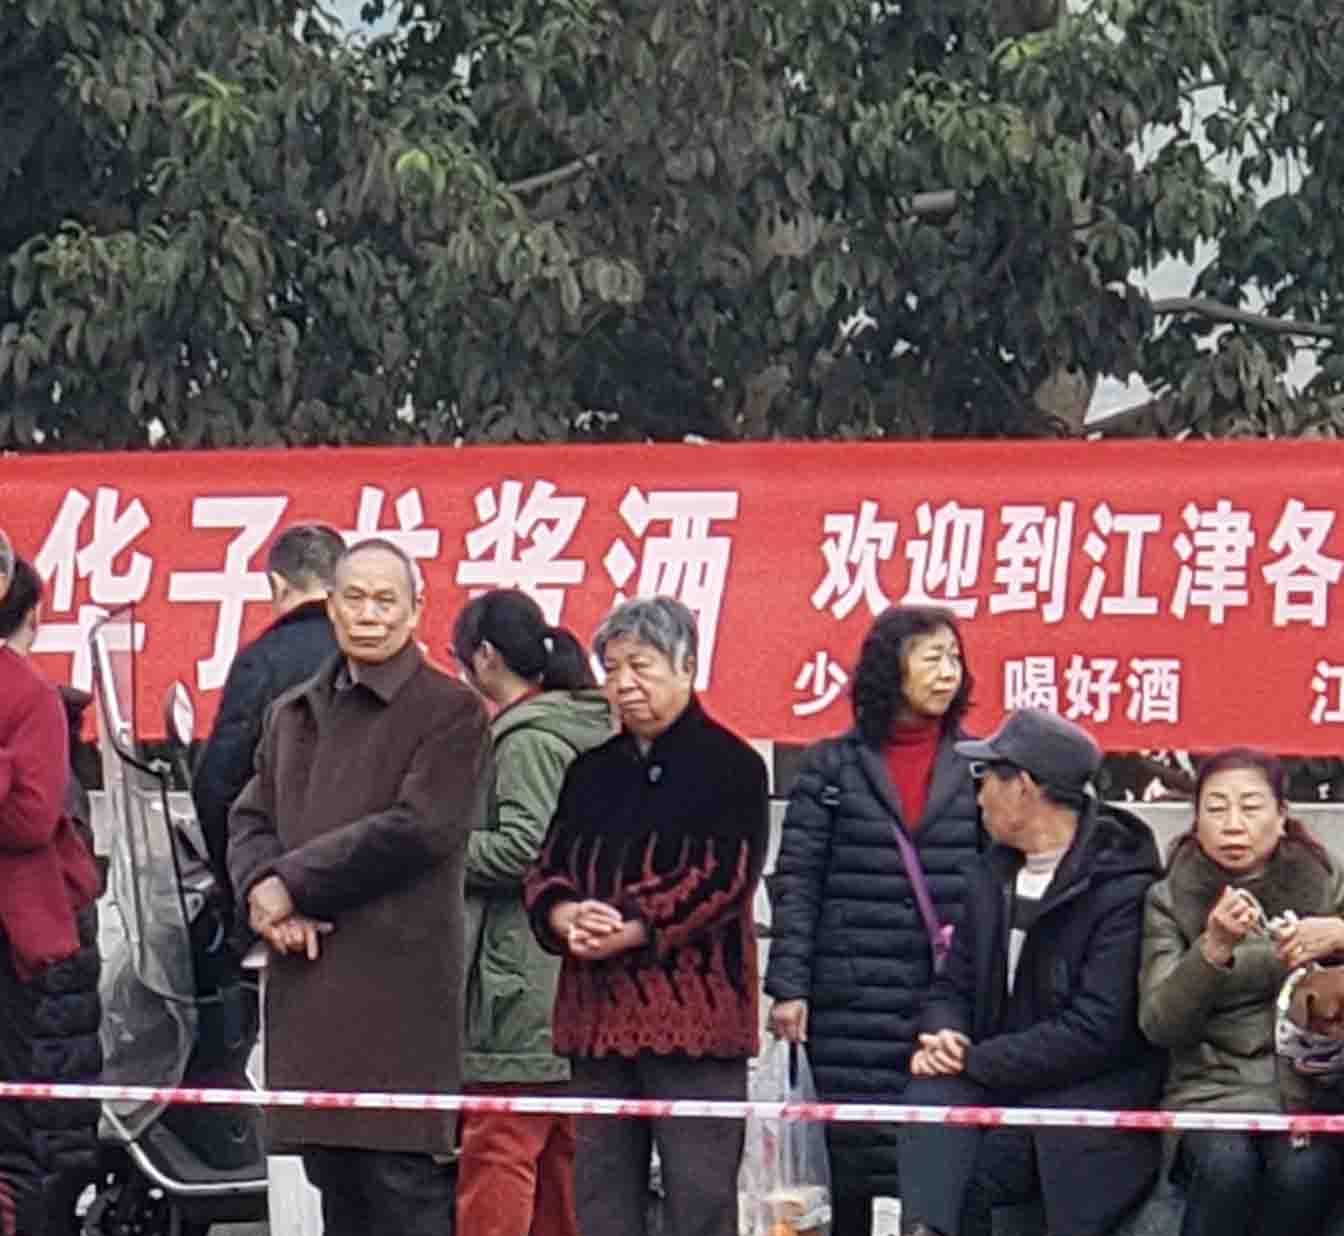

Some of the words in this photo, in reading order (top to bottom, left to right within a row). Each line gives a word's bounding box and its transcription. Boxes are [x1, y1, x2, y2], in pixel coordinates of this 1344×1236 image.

[30, 479, 740, 692] 华子酱酒
[1004, 655, 1181, 723] 喝好酒
